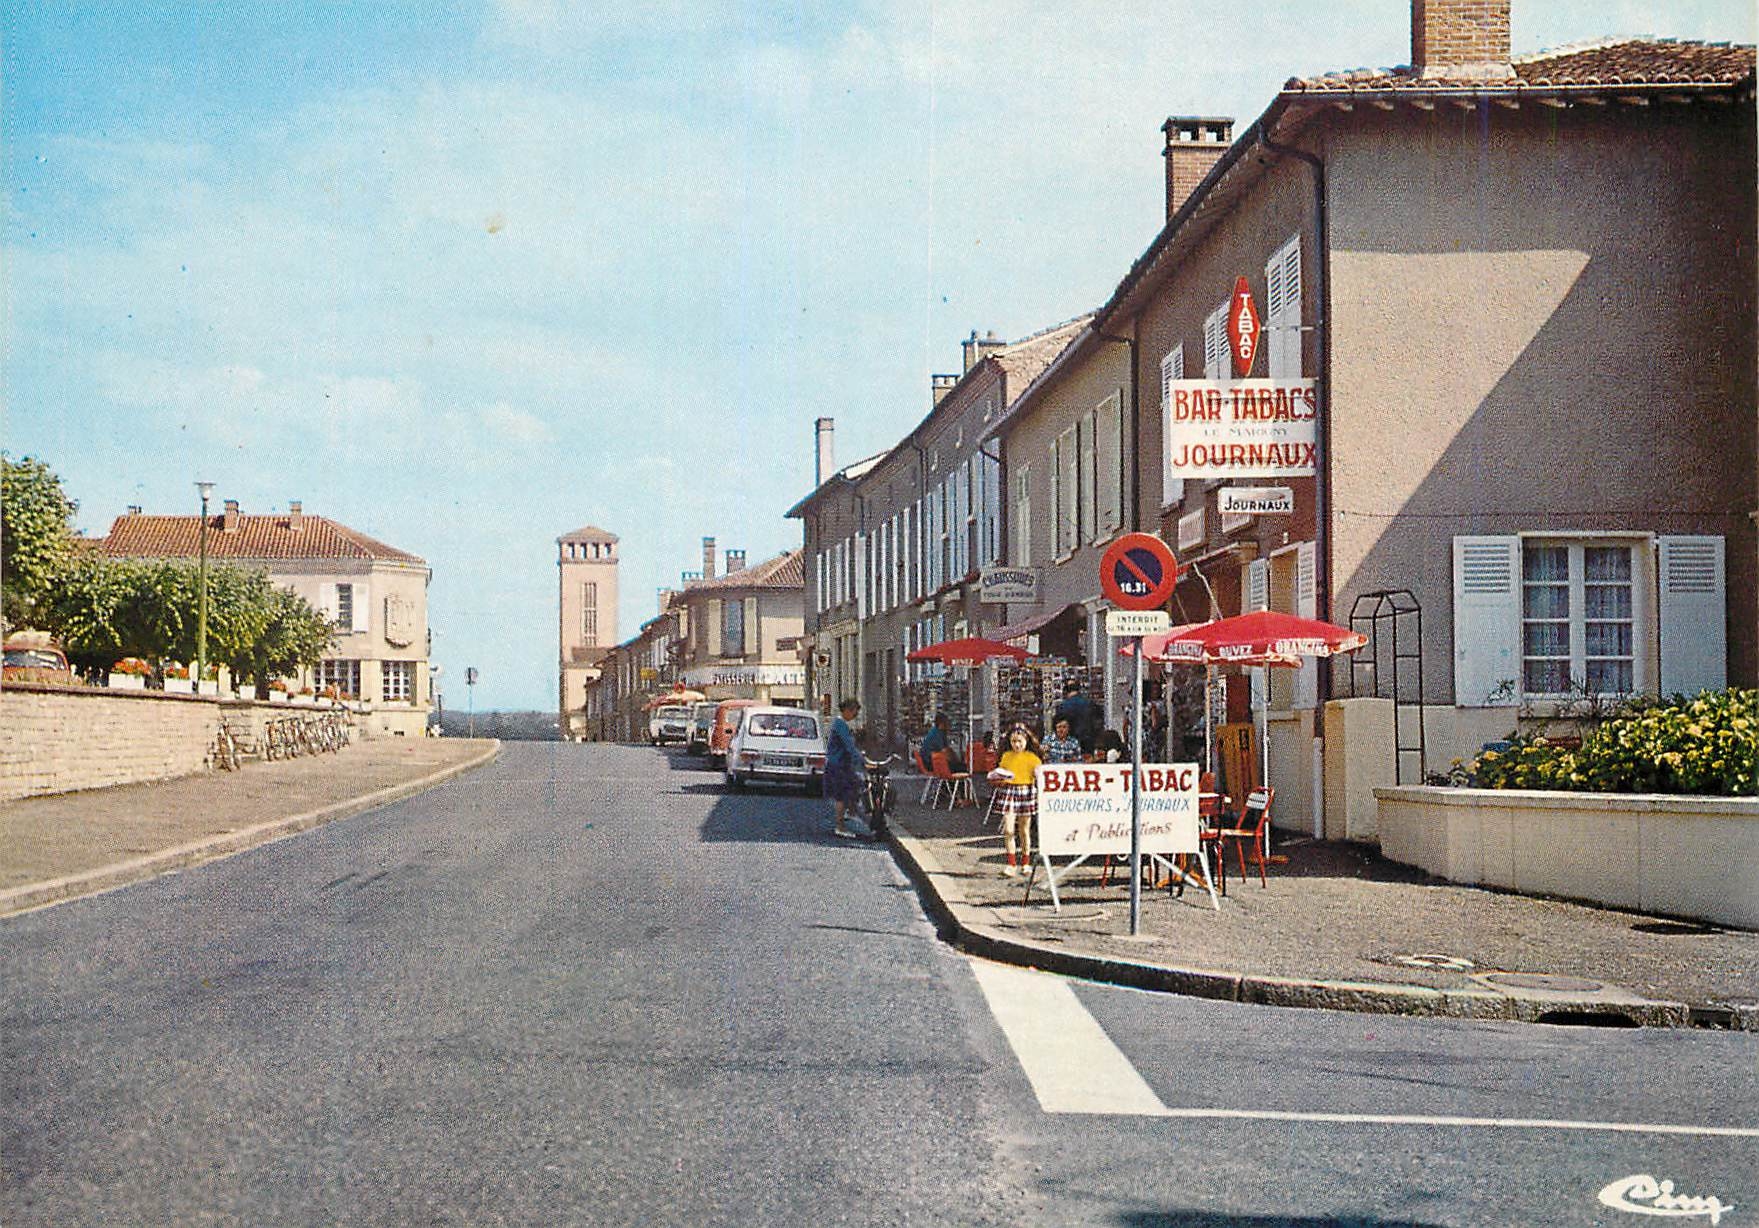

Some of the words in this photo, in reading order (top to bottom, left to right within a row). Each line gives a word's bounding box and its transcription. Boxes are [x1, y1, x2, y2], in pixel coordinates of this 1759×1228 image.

[1238, 293, 1254, 359] TABAC
[1173, 443, 1316, 467] JOURNAUX
[1117, 616, 1158, 624] INTERDIT
[1219, 645, 1252, 657] BUVEZ
[1123, 797, 1190, 812] JURNAUX
[1064, 830, 1078, 841] et
[1088, 822, 1172, 841] Publictions
